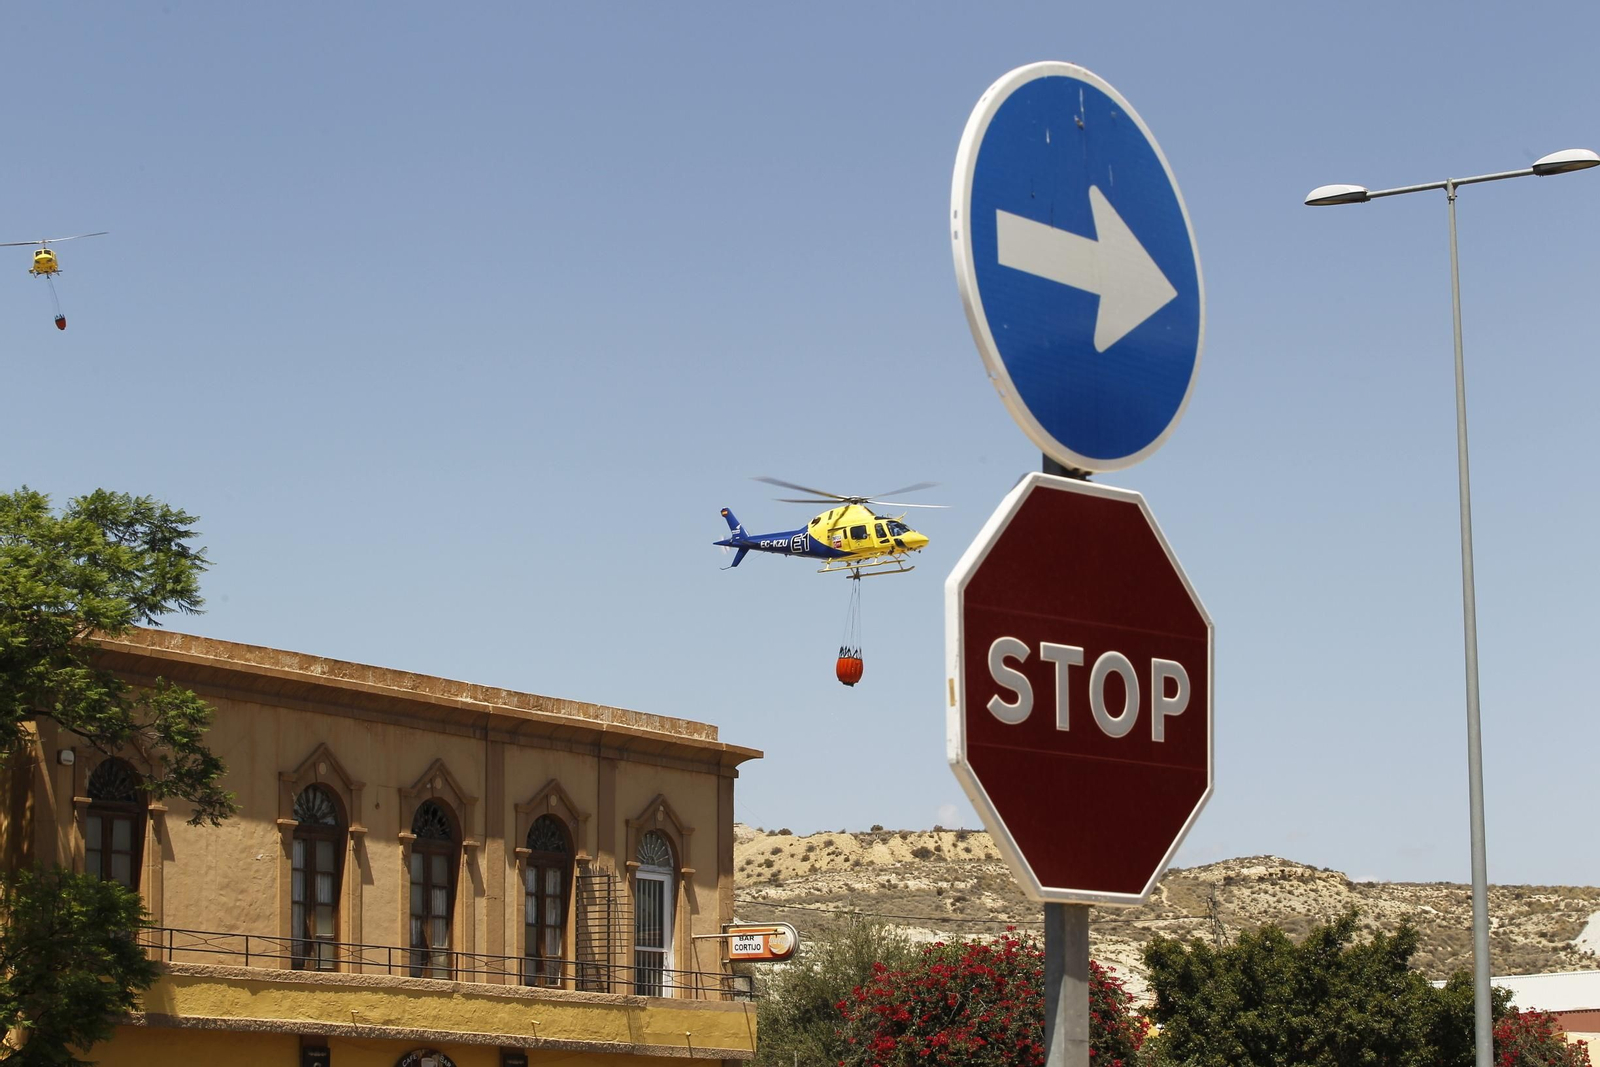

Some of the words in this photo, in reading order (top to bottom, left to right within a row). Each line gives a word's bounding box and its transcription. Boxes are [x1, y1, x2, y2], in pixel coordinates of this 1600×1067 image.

[760, 539, 788, 548] EC-KZU
[790, 532, 810, 552] E1
[986, 636, 1191, 743] STOP
[734, 943, 761, 951] CORTIJO
[439, 1055, 452, 1067] BAR
